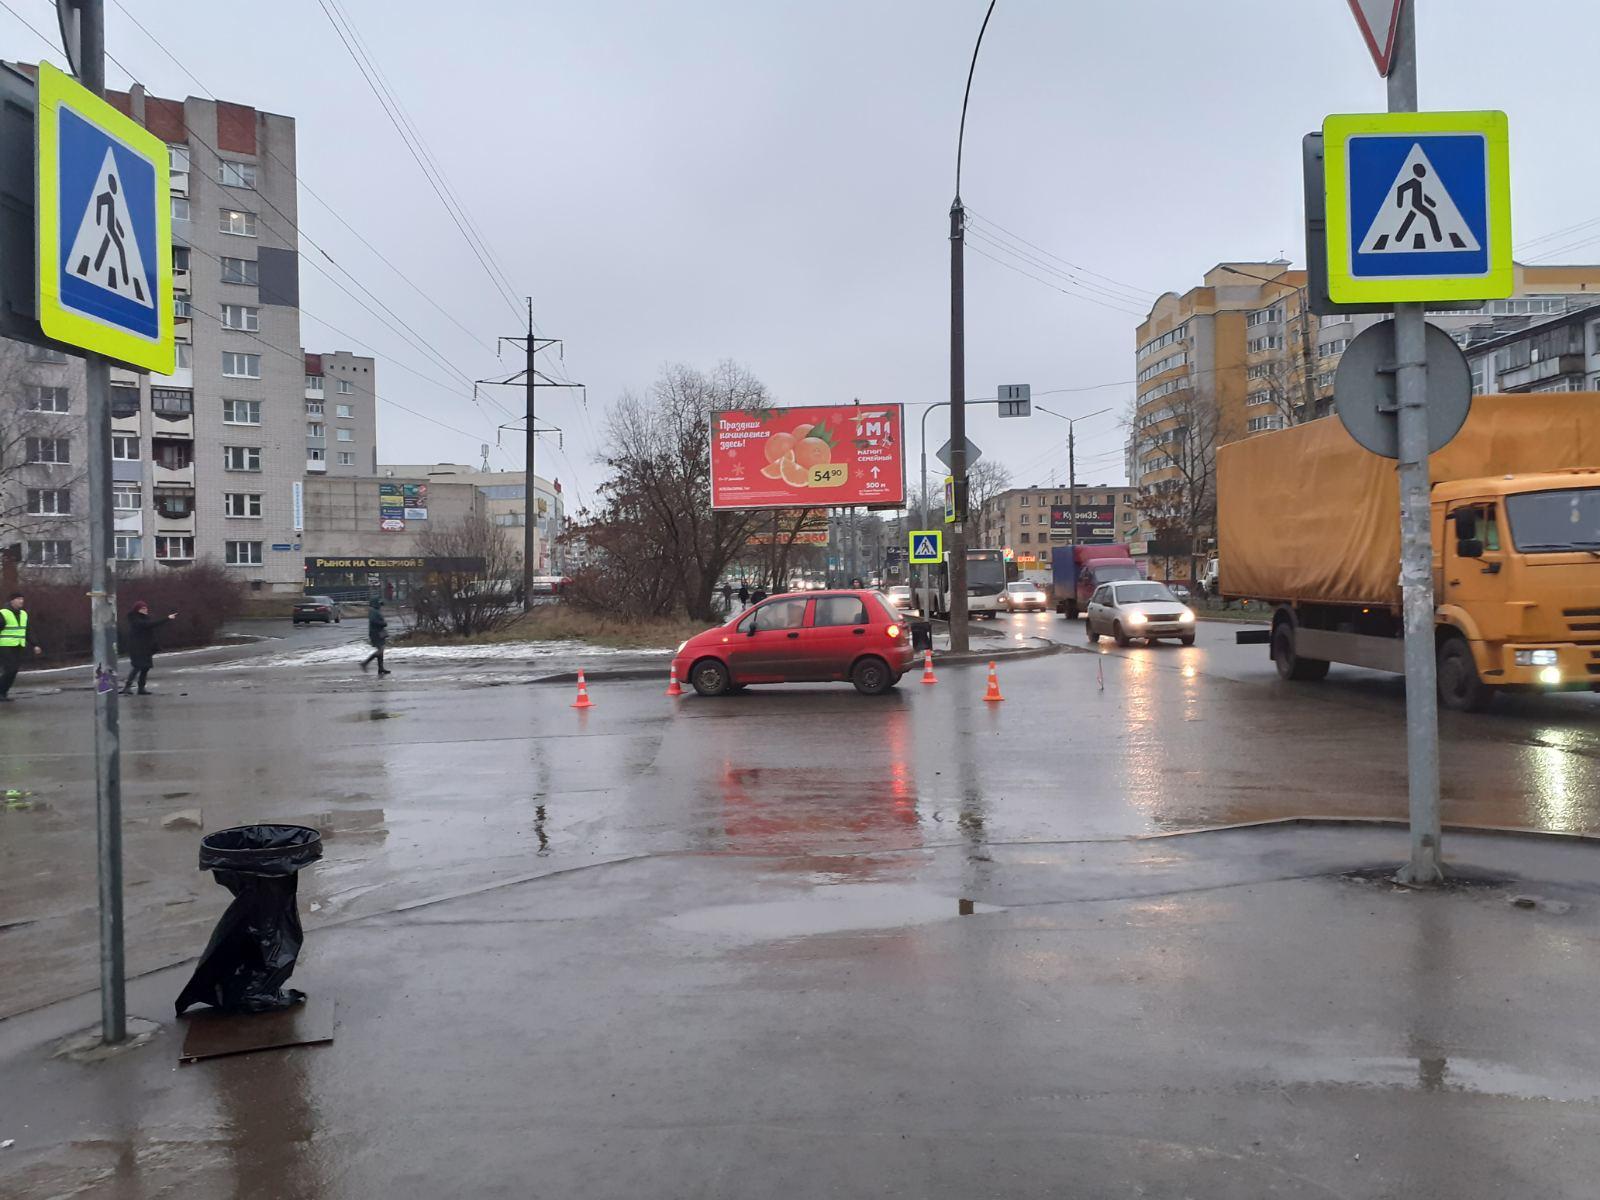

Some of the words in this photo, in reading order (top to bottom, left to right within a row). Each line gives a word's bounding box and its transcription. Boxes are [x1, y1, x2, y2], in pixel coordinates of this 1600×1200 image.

[719, 420, 760, 431] Праздник
[719, 431, 770, 440] начинается
[719, 439, 746, 450] здесь!
